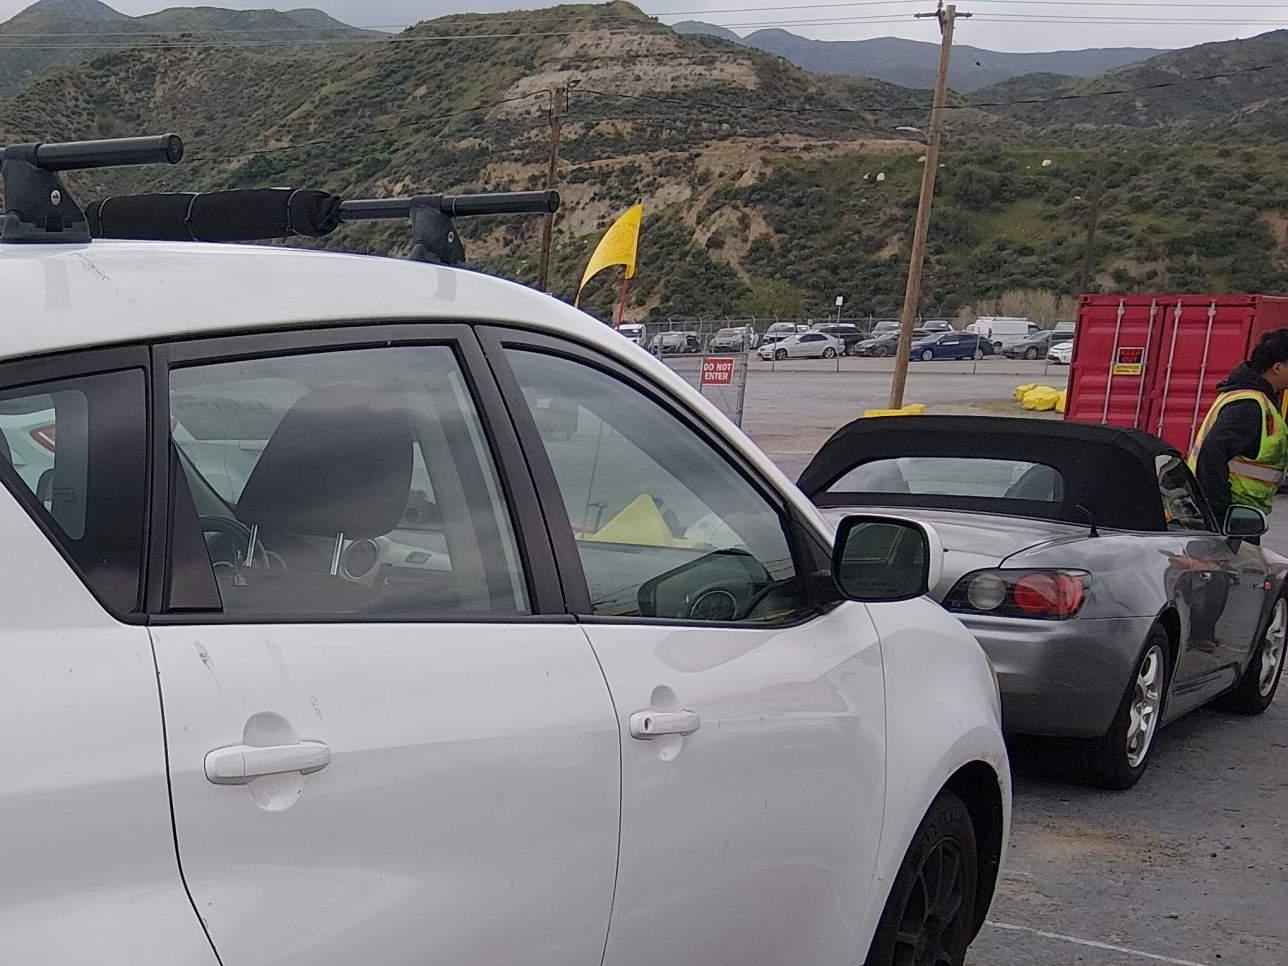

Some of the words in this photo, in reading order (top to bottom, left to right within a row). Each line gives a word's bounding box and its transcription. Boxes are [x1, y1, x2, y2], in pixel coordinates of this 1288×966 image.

[704, 363, 714, 371] DO
[716, 363, 732, 371] NOT
[704, 372, 728, 380] ENTER
